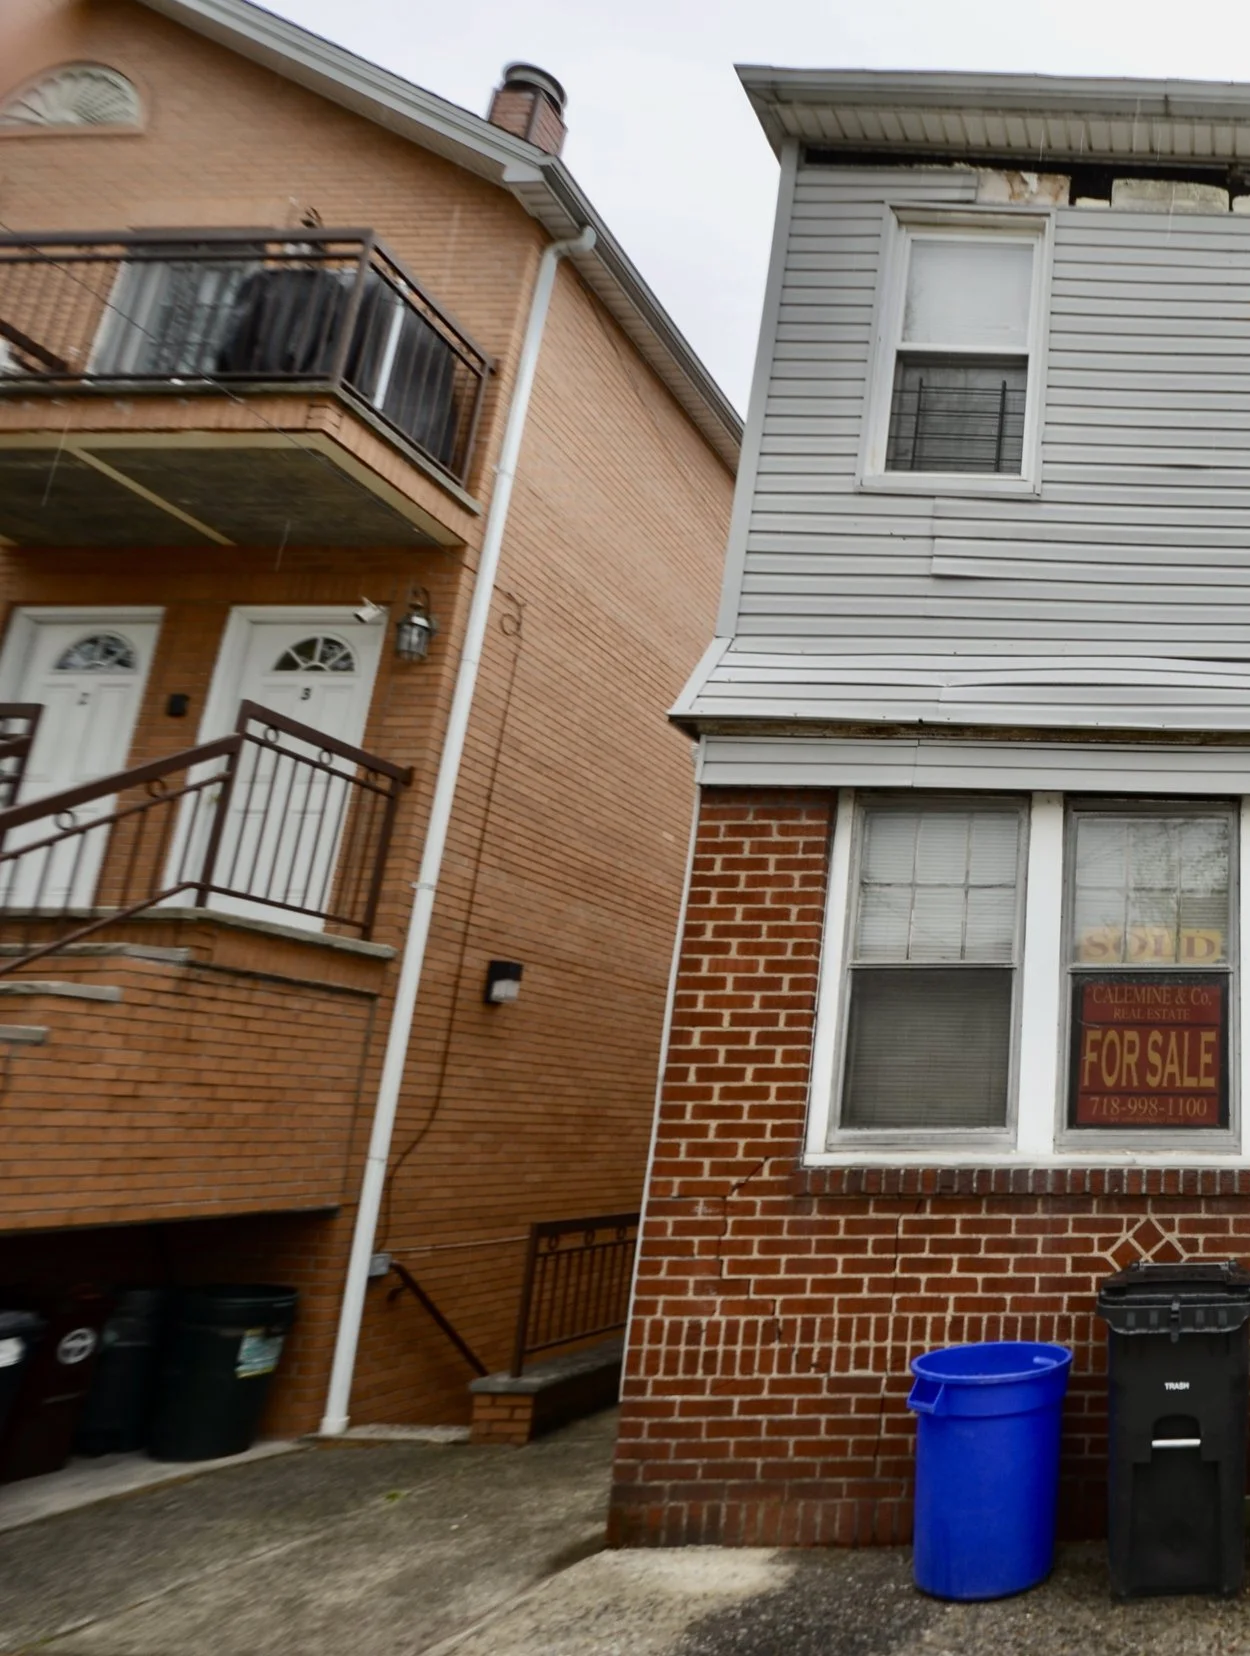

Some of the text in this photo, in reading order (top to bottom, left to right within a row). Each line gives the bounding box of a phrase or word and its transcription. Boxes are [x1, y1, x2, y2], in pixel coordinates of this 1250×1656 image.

[300, 687, 312, 701] 3
[1083, 932, 1216, 958] SOLD
[1093, 985, 1212, 1006] CALEMINE & Co.
[1113, 1007, 1190, 1020] REAL ESTATE
[1083, 1030, 1217, 1088] FOR SALE
[1090, 1097, 1207, 1116] 718-998-1100
[1164, 1381, 1190, 1391] TRASH
